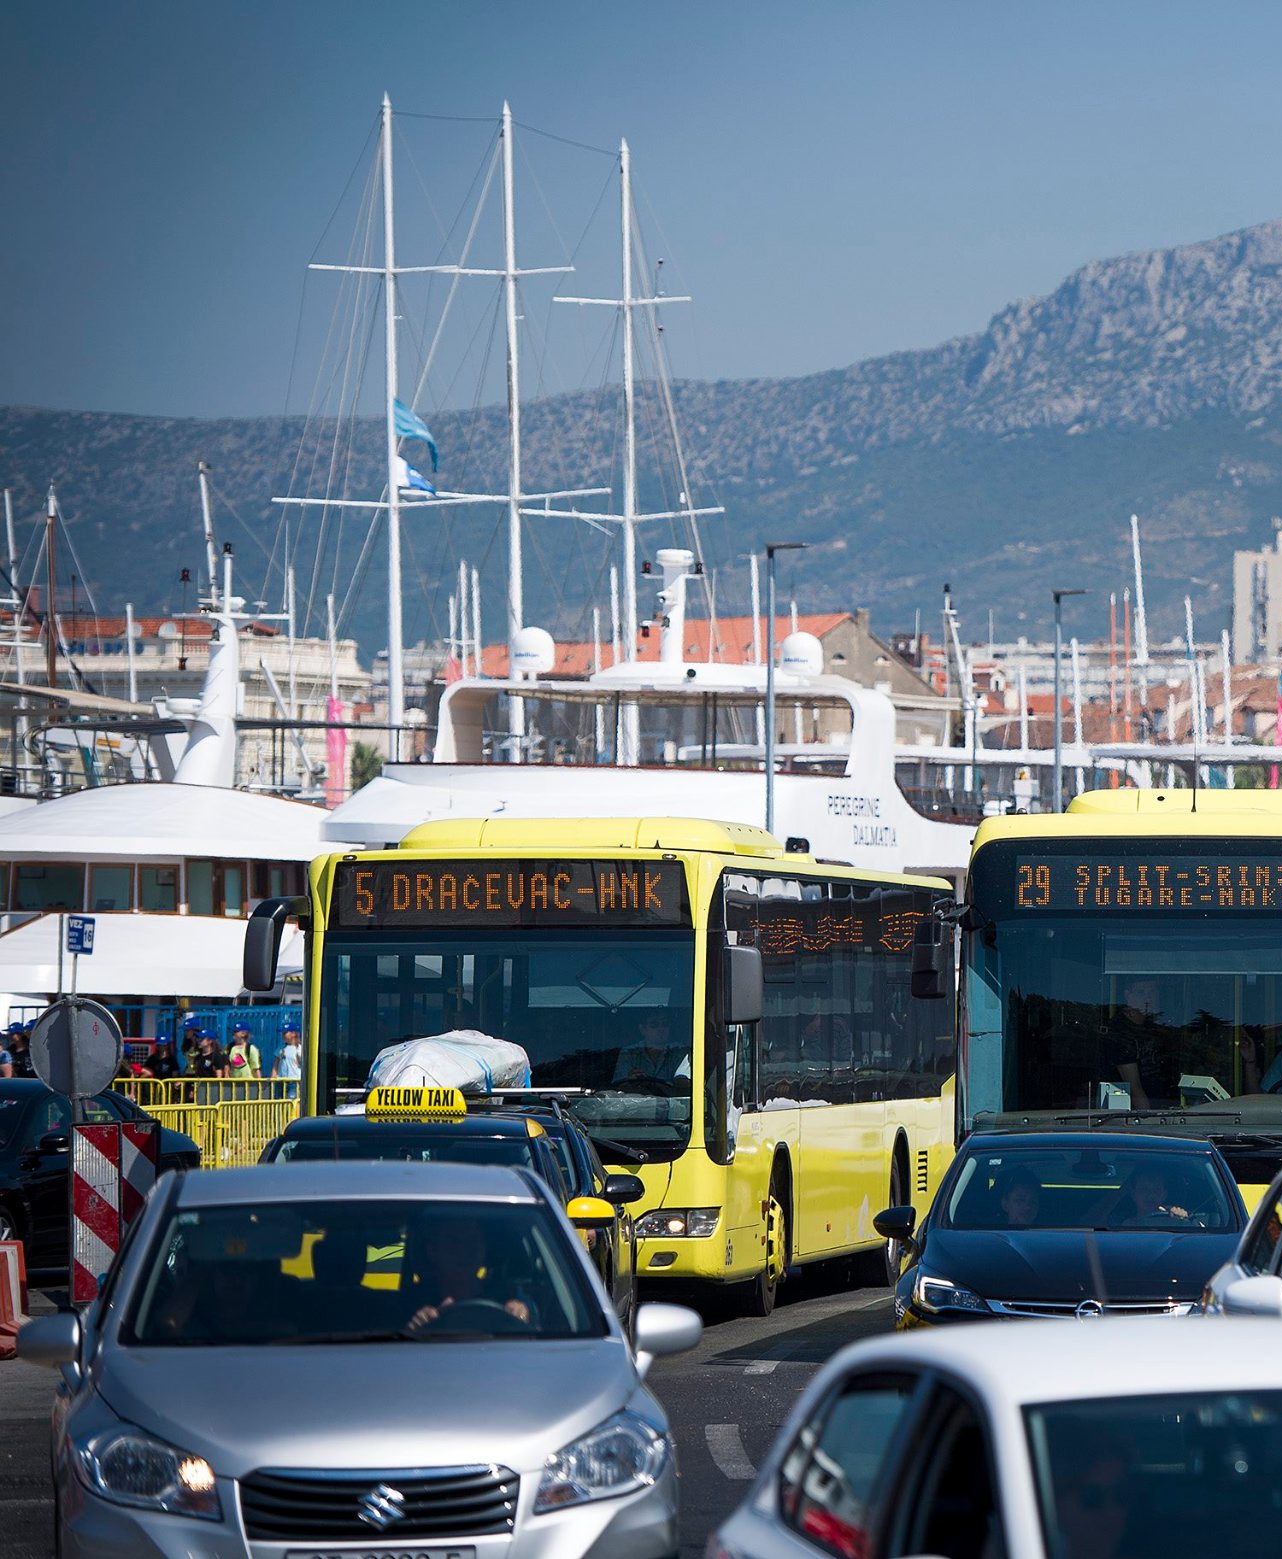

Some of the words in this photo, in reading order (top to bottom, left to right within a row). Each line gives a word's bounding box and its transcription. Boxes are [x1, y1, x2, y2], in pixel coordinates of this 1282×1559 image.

[827, 795, 880, 818] PEREGRINE
[853, 825, 898, 847] DALMATIA
[356, 872, 373, 915] 5
[1018, 865, 1050, 905] 29
[377, 1089, 423, 1106] YELLOW
[428, 1089, 454, 1107] TAXI
